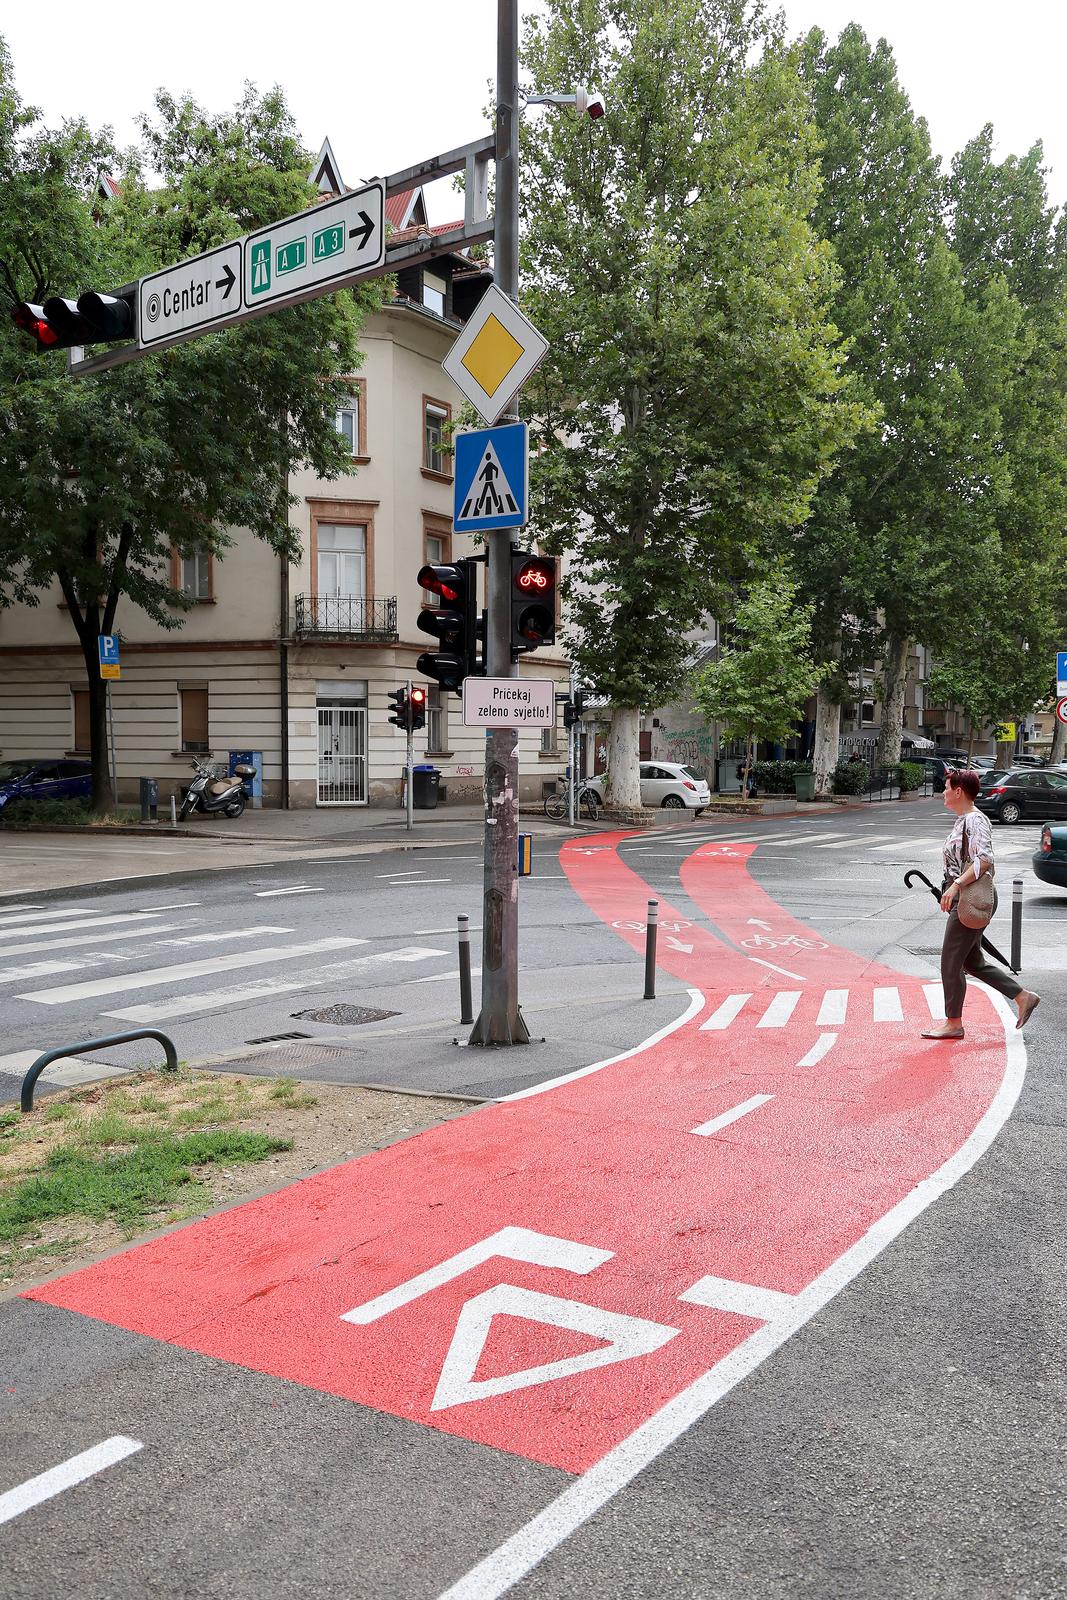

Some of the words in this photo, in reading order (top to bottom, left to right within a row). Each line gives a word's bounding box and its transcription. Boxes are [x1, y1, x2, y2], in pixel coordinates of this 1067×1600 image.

[163, 280, 211, 317] Centar
[103, 636, 114, 656] P
[493, 687, 531, 703] Pričekaj
[478, 704, 509, 717] zeleno
[513, 705, 549, 720] svjetlo!
[838, 736, 876, 747] arlovačko
